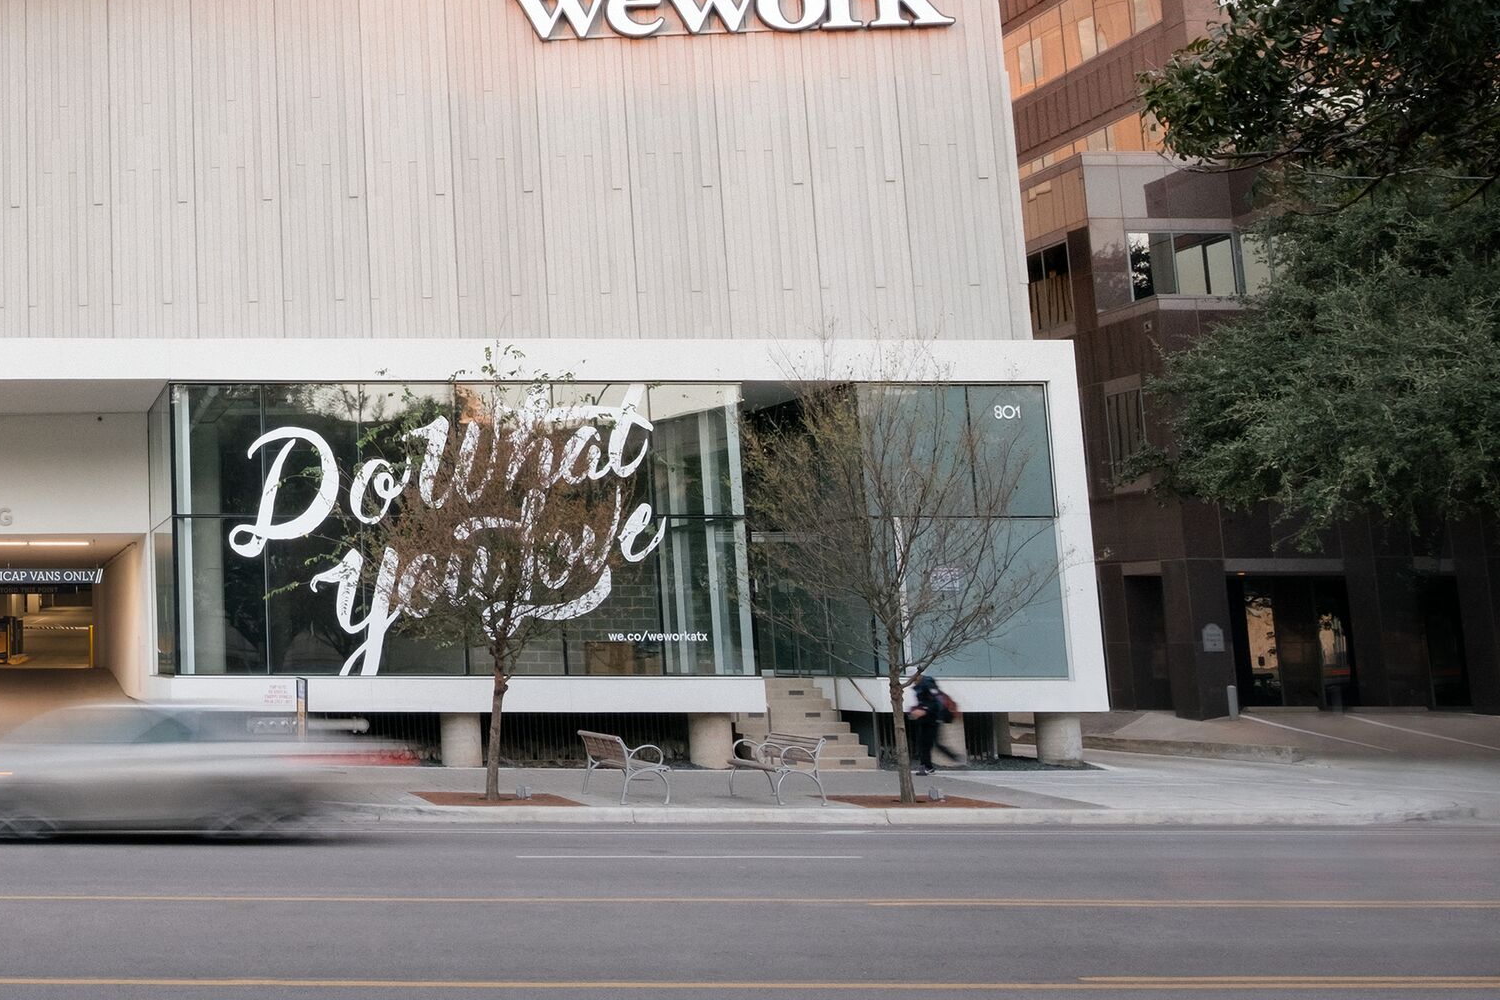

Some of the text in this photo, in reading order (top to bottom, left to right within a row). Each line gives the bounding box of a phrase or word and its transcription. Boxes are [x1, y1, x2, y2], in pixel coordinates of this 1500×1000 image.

[993, 405, 1021, 419] 801
[229, 426, 411, 557] Do
[29, 571, 61, 581] VANS
[63, 571, 95, 581] ONLY
[608, 630, 708, 642] we.co/weworkatx
